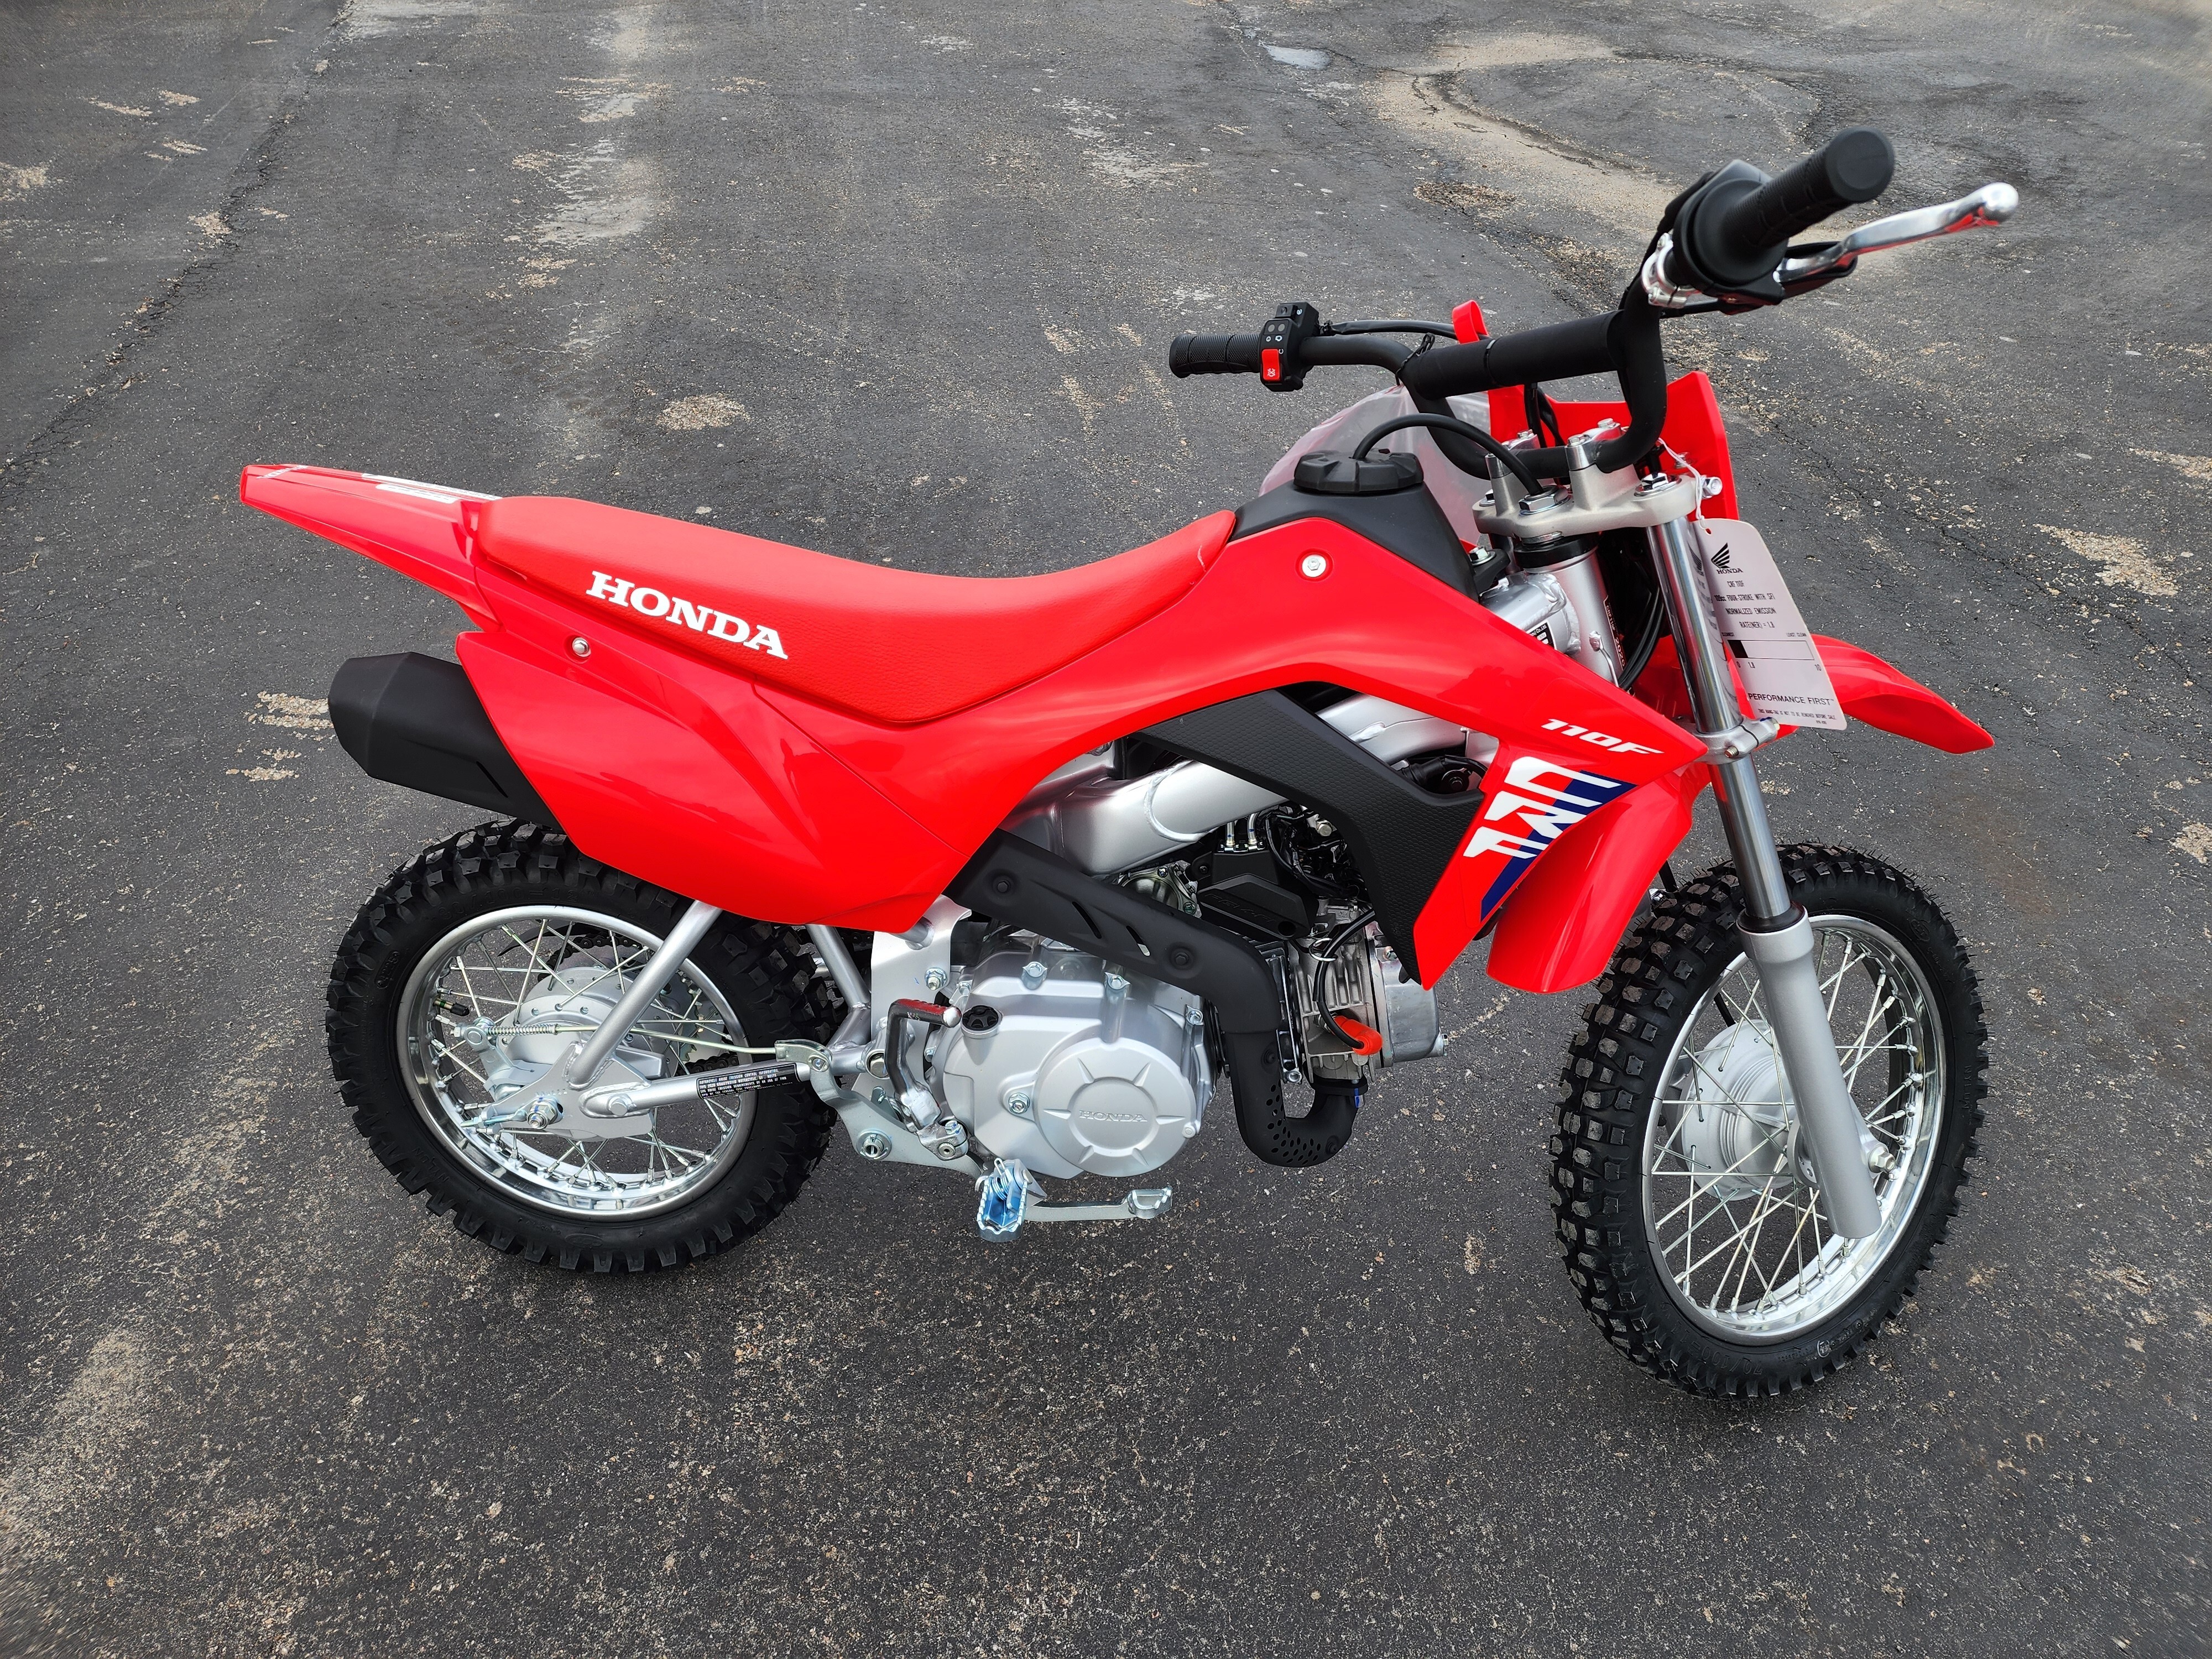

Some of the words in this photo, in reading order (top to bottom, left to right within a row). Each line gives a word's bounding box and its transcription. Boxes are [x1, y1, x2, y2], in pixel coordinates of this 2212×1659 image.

[586, 571, 789, 660] HONDA
[1747, 693, 1806, 703] PERFORMANCE
[1541, 718, 1665, 754] 110F
[1463, 756, 1622, 859] CRF
[1078, 1109, 1147, 1123] HONDA
